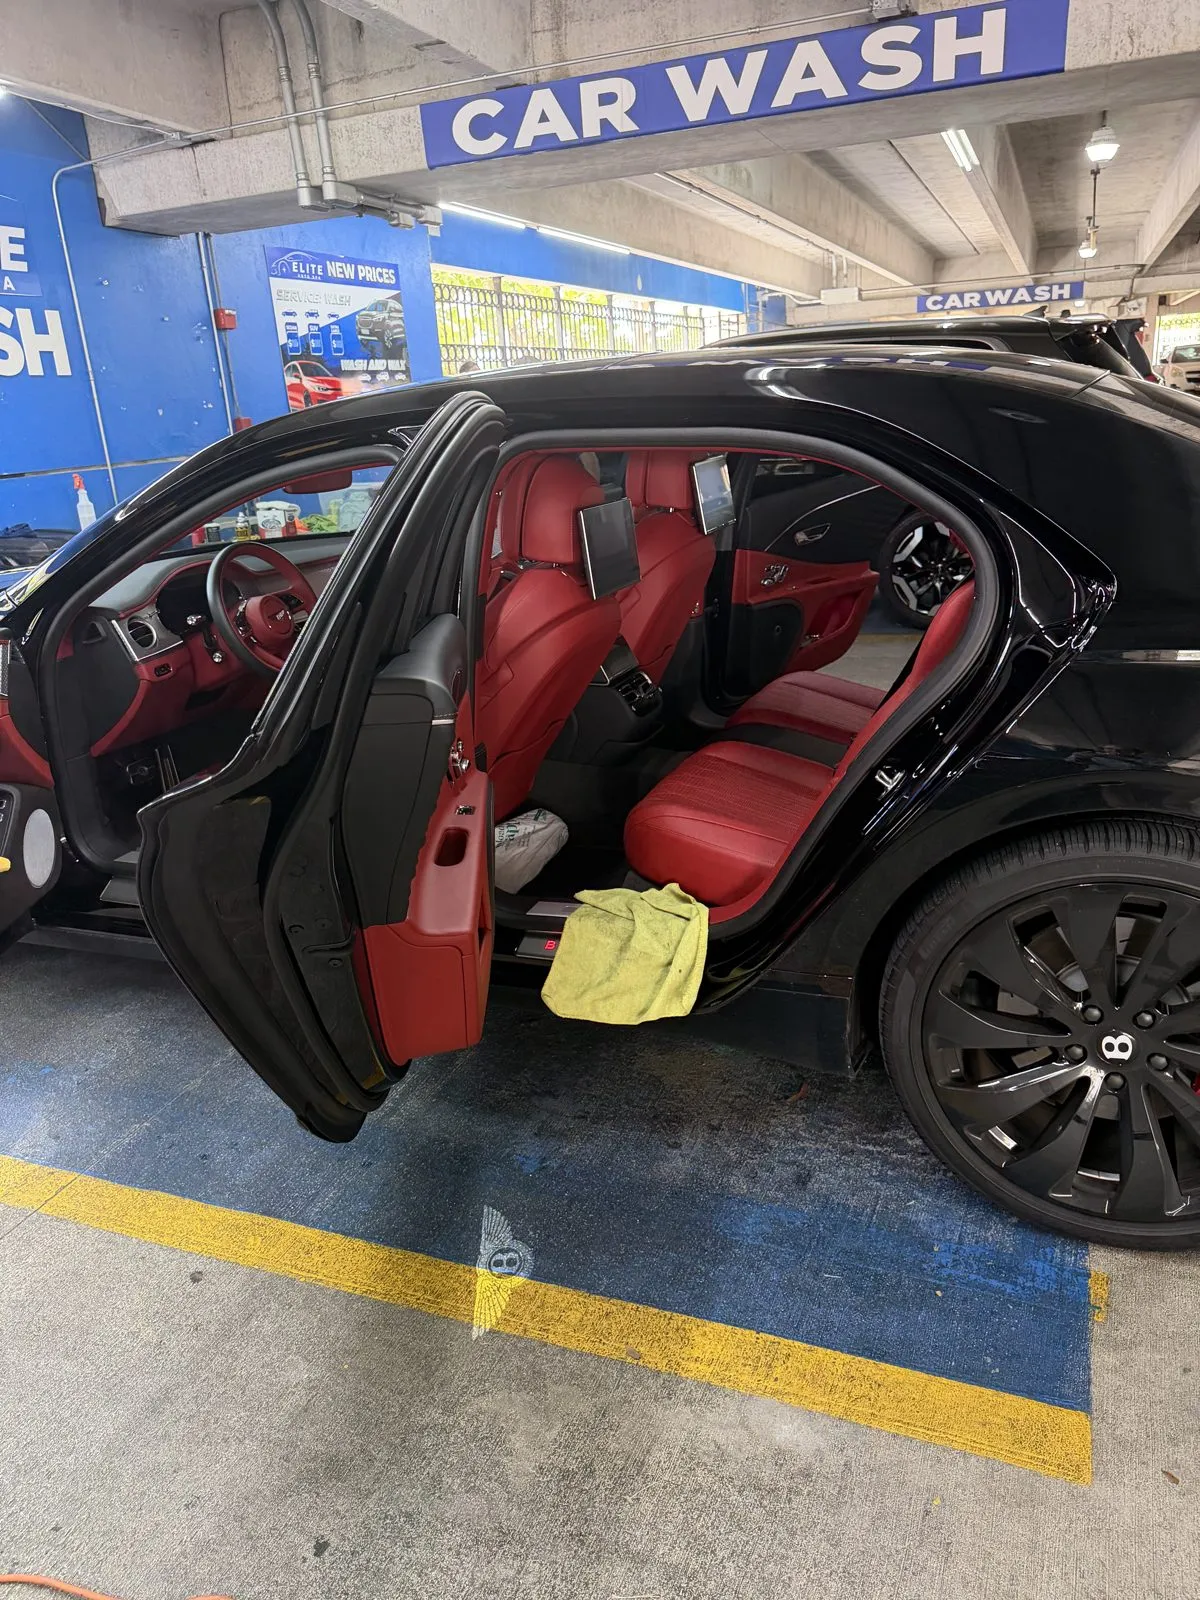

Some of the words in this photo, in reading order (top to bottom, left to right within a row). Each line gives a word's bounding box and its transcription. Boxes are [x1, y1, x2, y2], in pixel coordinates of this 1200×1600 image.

[451, 77, 640, 155] CAR
[665, 8, 1007, 122] WASH
[292, 262, 323, 276] ELITE
[326, 260, 355, 280] NEW
[357, 265, 396, 285] PRICES
[3, 276, 16, 291] A
[276, 288, 321, 304] SERVICE
[324, 292, 351, 306] WASH
[925, 292, 981, 311] CAR
[984, 283, 1071, 305] WASH
[340, 359, 368, 371] WASH
[368, 359, 387, 371] AND
[388, 359, 407, 371] WAX
[544, 940, 557, 950] B
[1101, 1034, 1133, 1061] B
[490, 1251, 519, 1274] B
